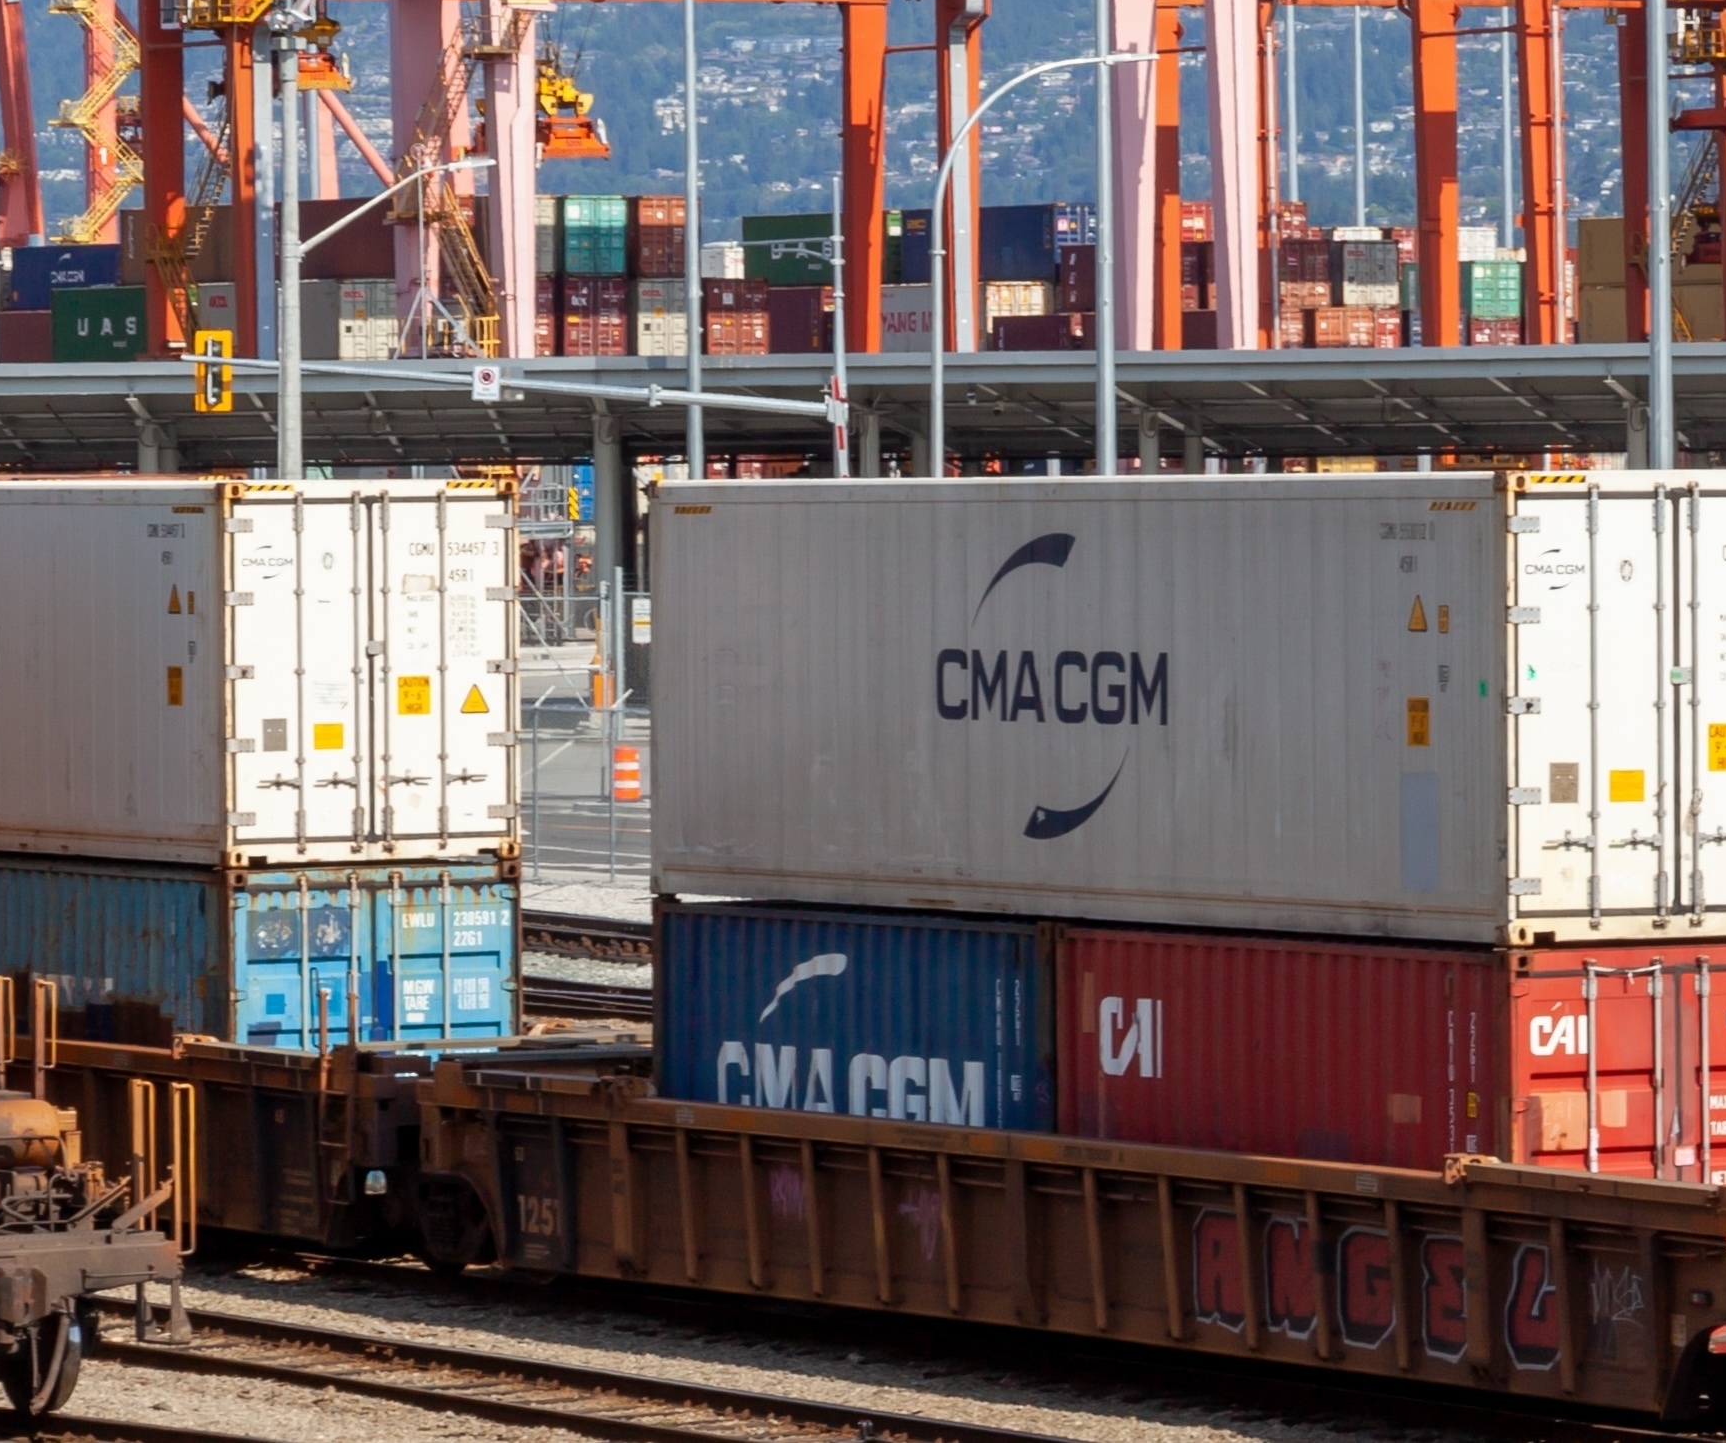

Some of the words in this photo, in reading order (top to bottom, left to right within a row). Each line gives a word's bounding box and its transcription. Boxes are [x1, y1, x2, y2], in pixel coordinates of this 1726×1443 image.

[408, 542, 436, 557] CGMU
[446, 541, 487, 557] 534457
[492, 541, 500, 556] 3
[241, 558, 265, 567] CMA
[268, 558, 294, 567] CGM
[1524, 564, 1553, 575] CMA
[1556, 564, 1586, 575] CGM
[447, 568, 475, 583] 45R1
[935, 648, 1046, 724] CMA
[1053, 650, 1170, 727] CGM
[401, 913, 436, 929] EWLU
[453, 911, 496, 928] 230591
[501, 910, 511, 927] 2
[452, 932, 483, 947] 22G1
[403, 995, 430, 1011] TARE
[1529, 1014, 1589, 1057] CAI
[848, 1052, 986, 1129] CGM
